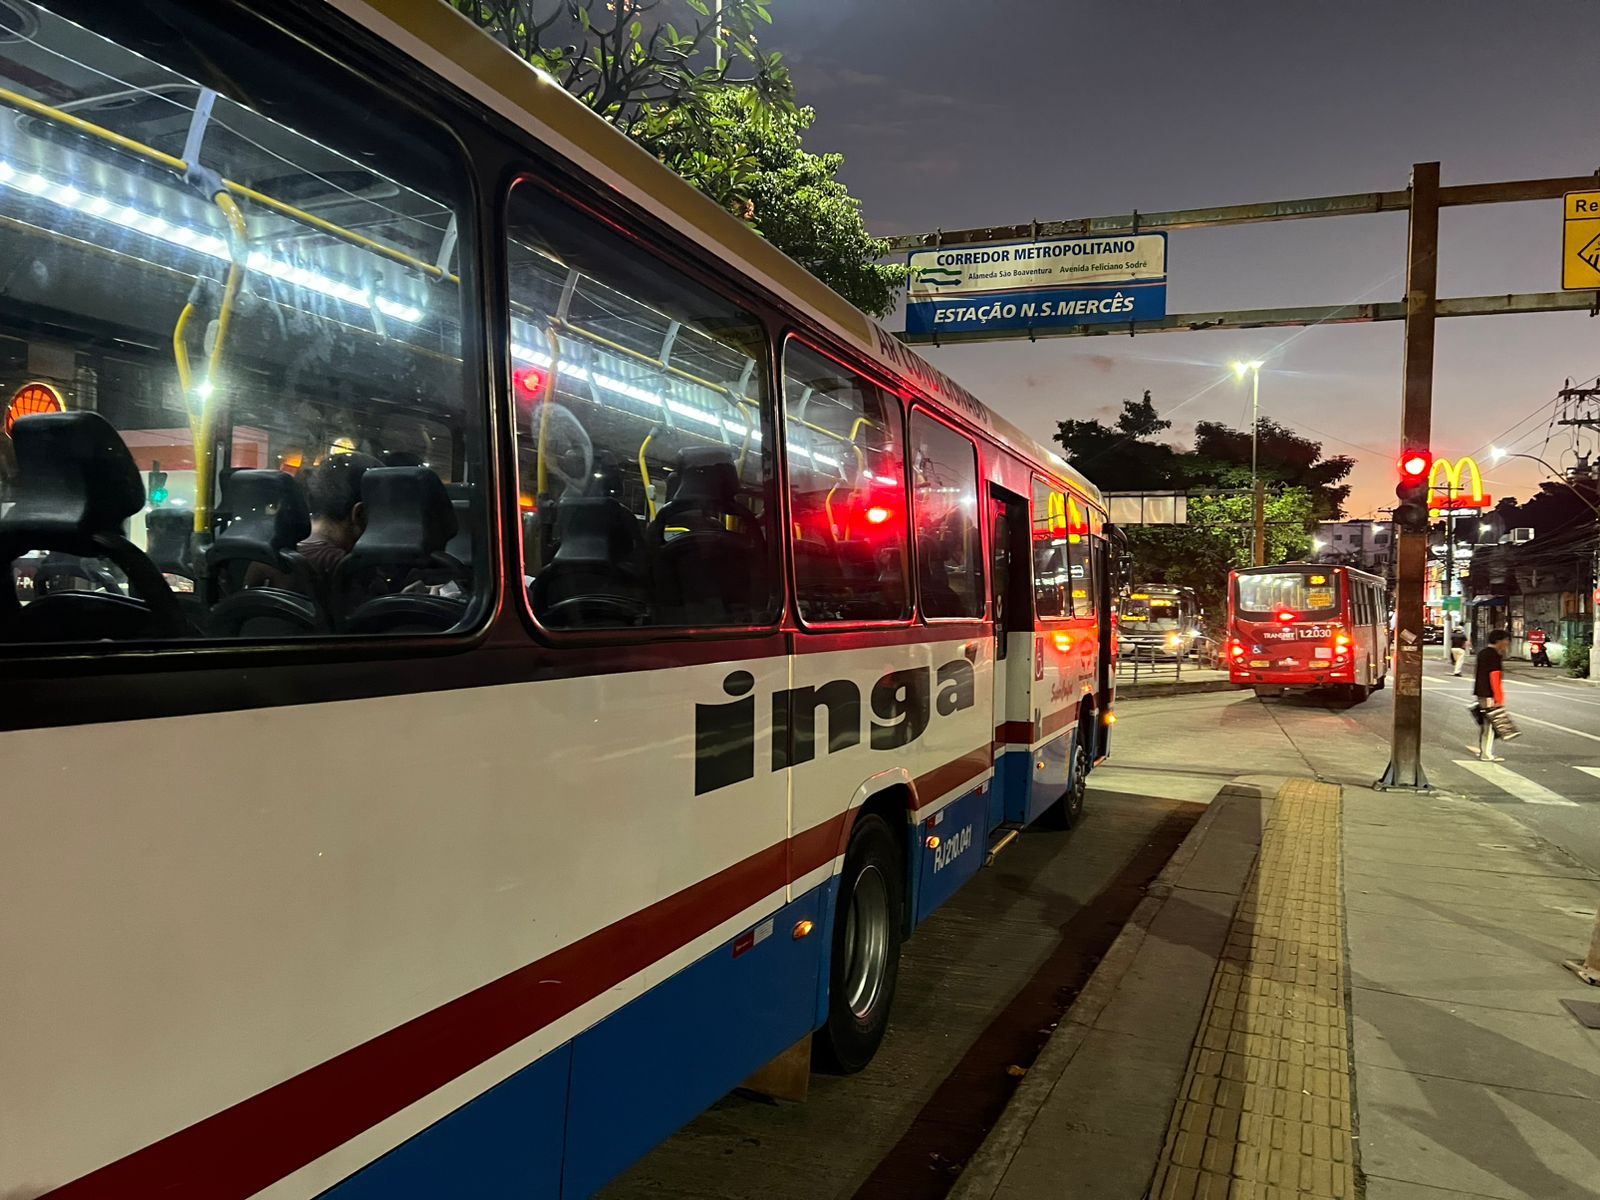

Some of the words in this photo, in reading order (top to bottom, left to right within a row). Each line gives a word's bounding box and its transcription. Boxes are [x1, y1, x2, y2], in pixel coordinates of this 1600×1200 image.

[936, 249, 1010, 267] CORREDOR
[1013, 240, 1135, 262] METROPOLITANO
[968, 269, 998, 281] Alameda
[998, 268, 1012, 279] São
[1013, 266, 1052, 277] Boaventura
[1059, 263, 1090, 275] Avenida
[1090, 261, 1124, 272] Feliciano
[1125, 259, 1148, 270] Sodré
[933, 300, 1016, 324] ESTAÇÃO
